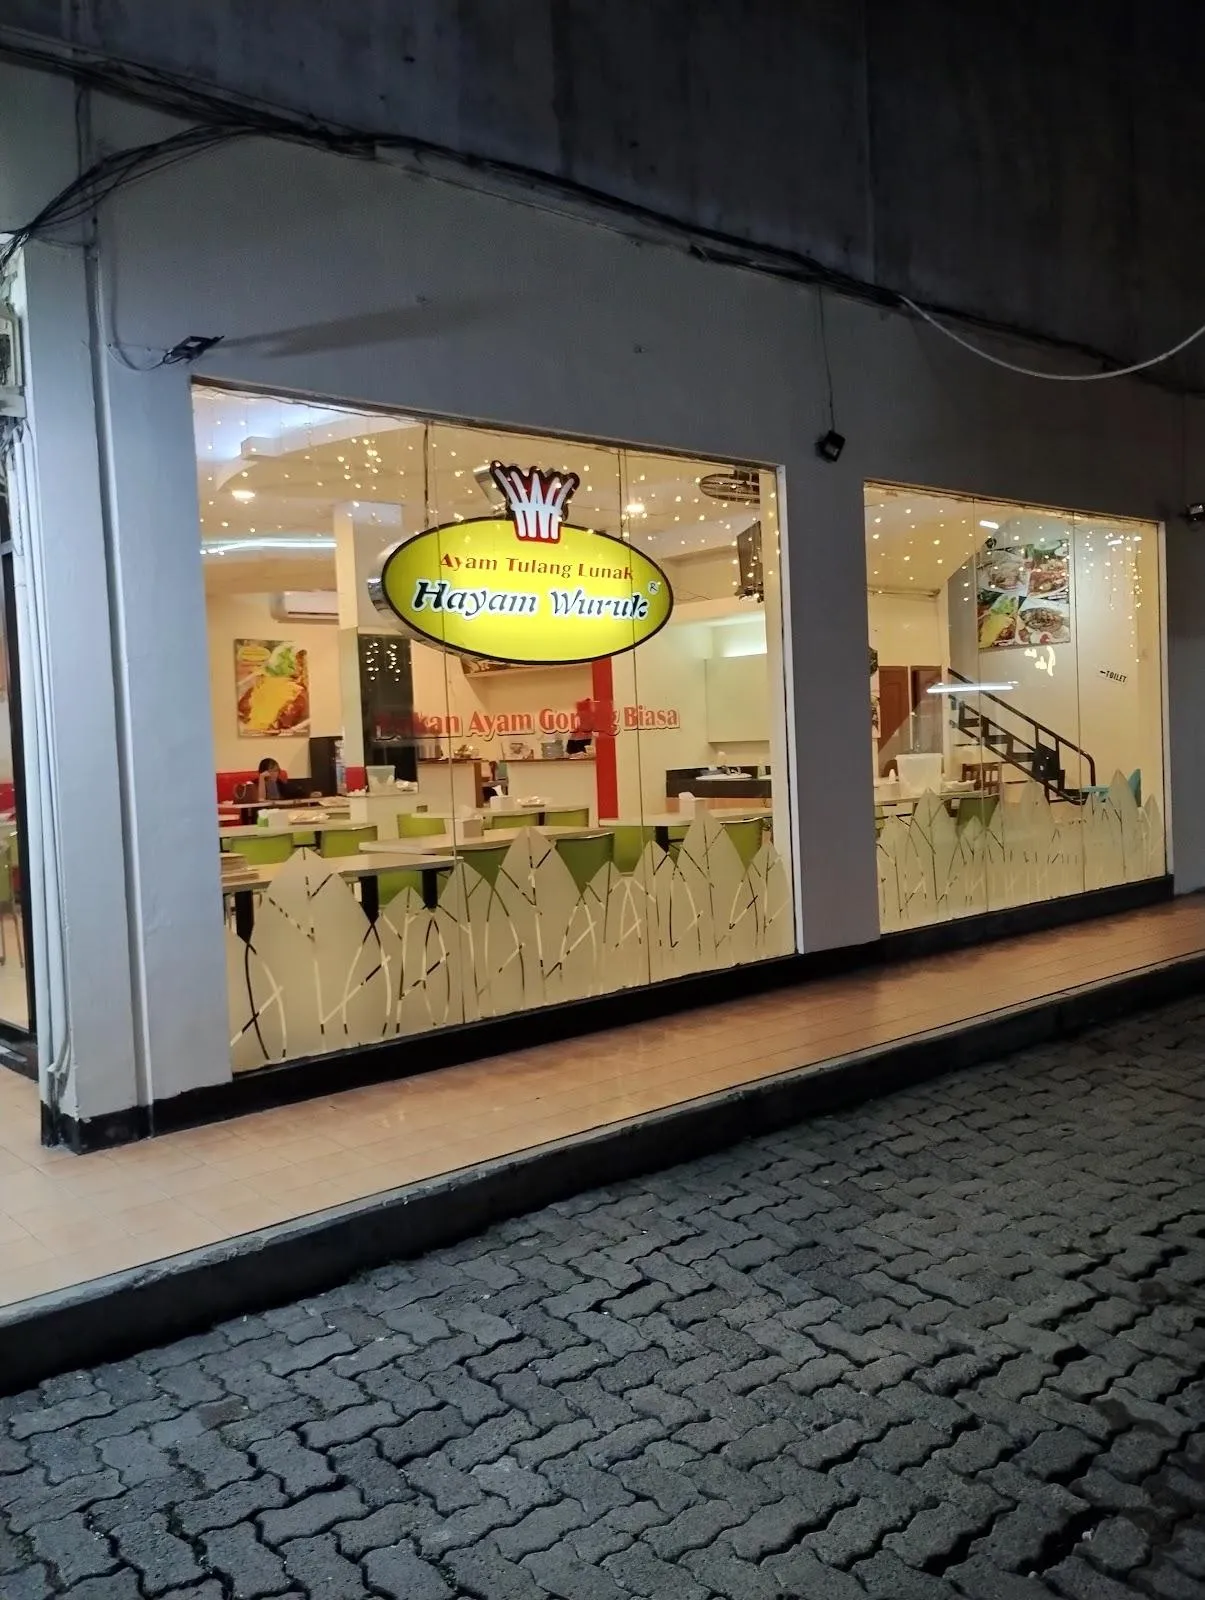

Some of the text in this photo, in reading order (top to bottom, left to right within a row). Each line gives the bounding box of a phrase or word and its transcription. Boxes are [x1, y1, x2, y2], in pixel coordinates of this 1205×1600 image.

[440, 553, 633, 580] Ayam Tulang Lunak
[413, 581, 648, 618] Hayam Wuruk
[1106, 670, 1127, 683] TOILET
[468, 711, 533, 740] Ayam
[623, 705, 679, 729] Biasa
